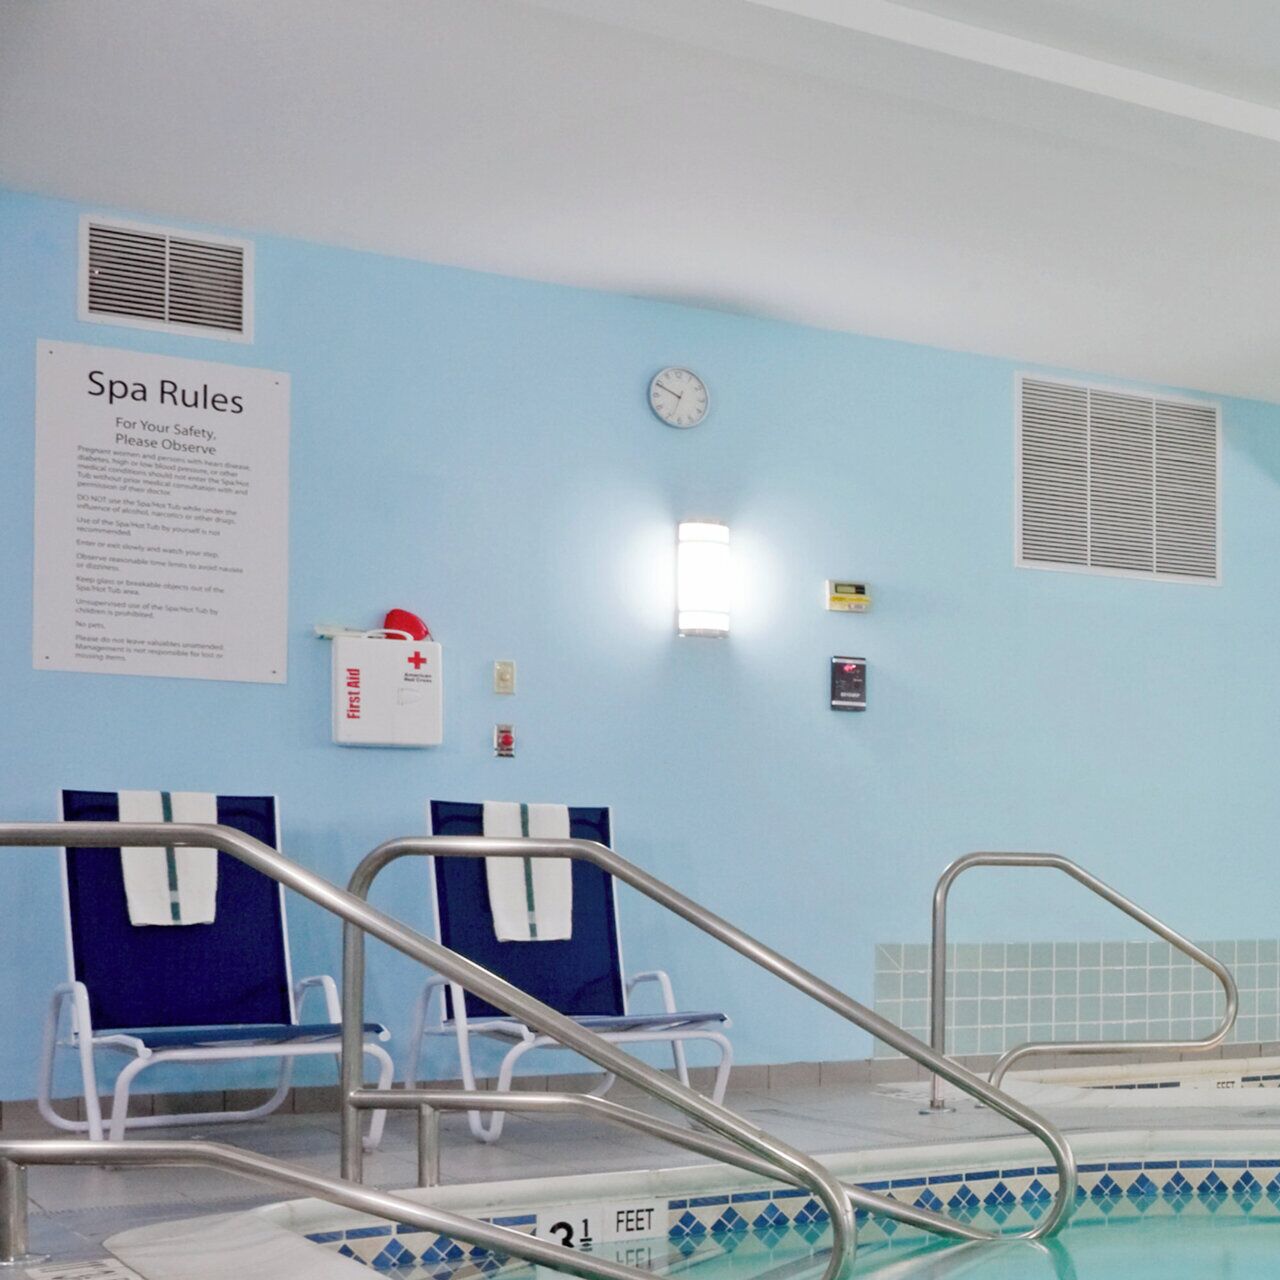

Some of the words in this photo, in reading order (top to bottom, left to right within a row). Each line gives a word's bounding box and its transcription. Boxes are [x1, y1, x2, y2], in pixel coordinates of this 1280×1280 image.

[87, 370, 148, 405] Spa
[160, 380, 244, 414] Rules
[115, 417, 137, 430] For
[140, 420, 170, 433] Your
[174, 424, 216, 441] Safety,
[115, 433, 159, 449] Please
[162, 438, 217, 456] Observe
[346, 668, 361, 688] Aid
[346, 690, 361, 720] First
[616, 1208, 654, 1232] FEET
